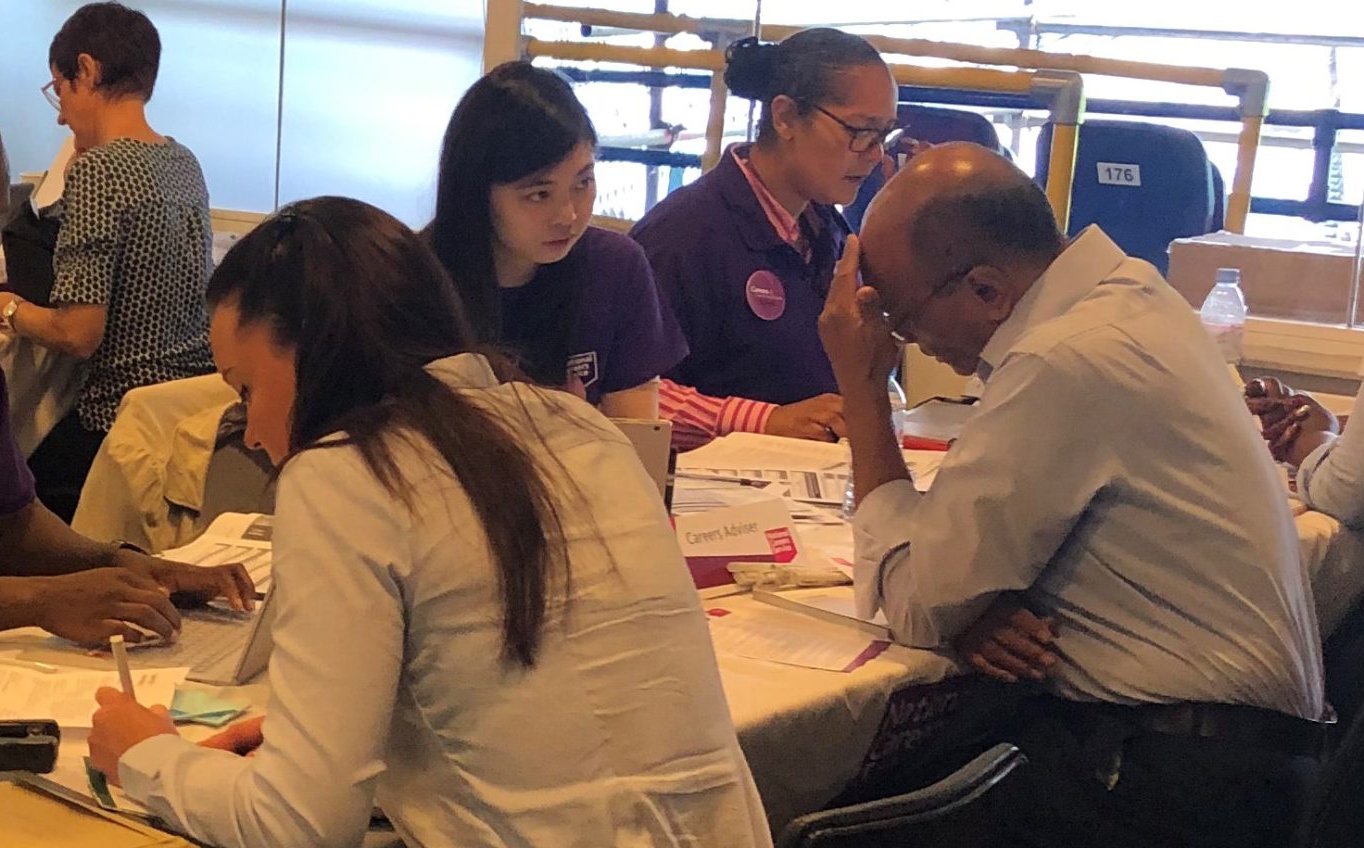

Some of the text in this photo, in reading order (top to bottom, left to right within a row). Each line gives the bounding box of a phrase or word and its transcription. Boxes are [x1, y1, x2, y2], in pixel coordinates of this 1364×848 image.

[1105, 167, 1134, 182] 176
[685, 521, 758, 545] Careers Adviser
